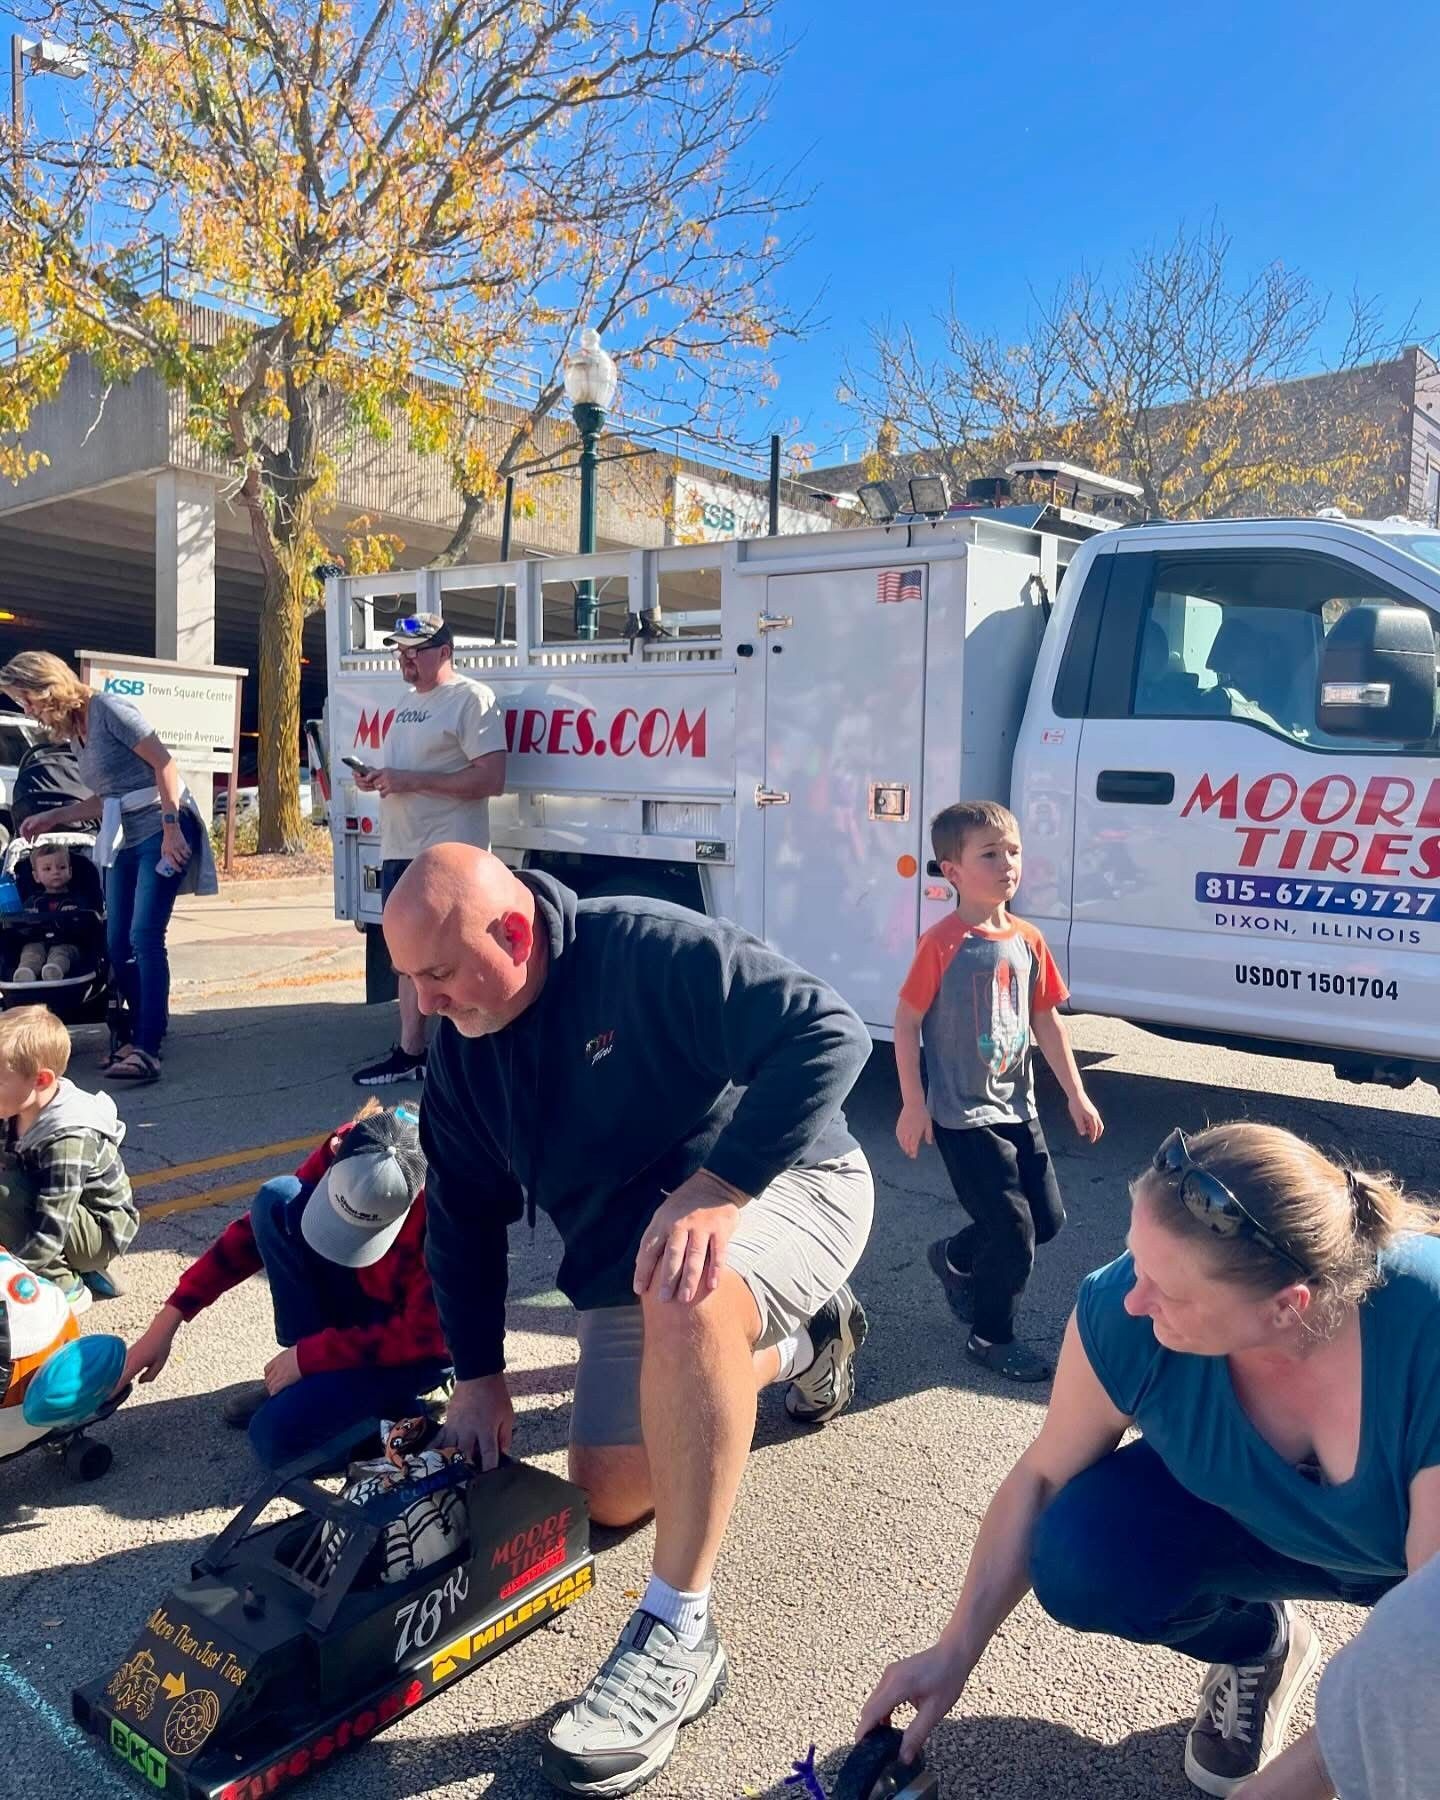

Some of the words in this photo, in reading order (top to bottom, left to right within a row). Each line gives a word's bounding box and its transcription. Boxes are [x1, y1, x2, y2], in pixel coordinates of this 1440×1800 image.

[104, 677, 145, 696] KSB
[148, 683, 172, 697] Town
[174, 686, 202, 700] Square
[205, 689, 233, 702] Centre
[194, 730, 225, 744] Avenue
[1234, 827, 1440, 880] TIRES
[1205, 878, 1436, 916] 815-677-9727
[1214, 912, 1297, 935] DIXON,
[1311, 922, 1422, 945] ILLINOIS
[1234, 963, 1302, 990] USDOT
[1307, 971, 1399, 1001] 1501704
[490, 1506, 573, 1570] MOORE
[472, 1565, 592, 1654] MILESTAR
[146, 1607, 175, 1640] More
[195, 1640, 223, 1669] Just
[219, 1653, 248, 1687] Tires
[112, 1720, 167, 1788] BKT
